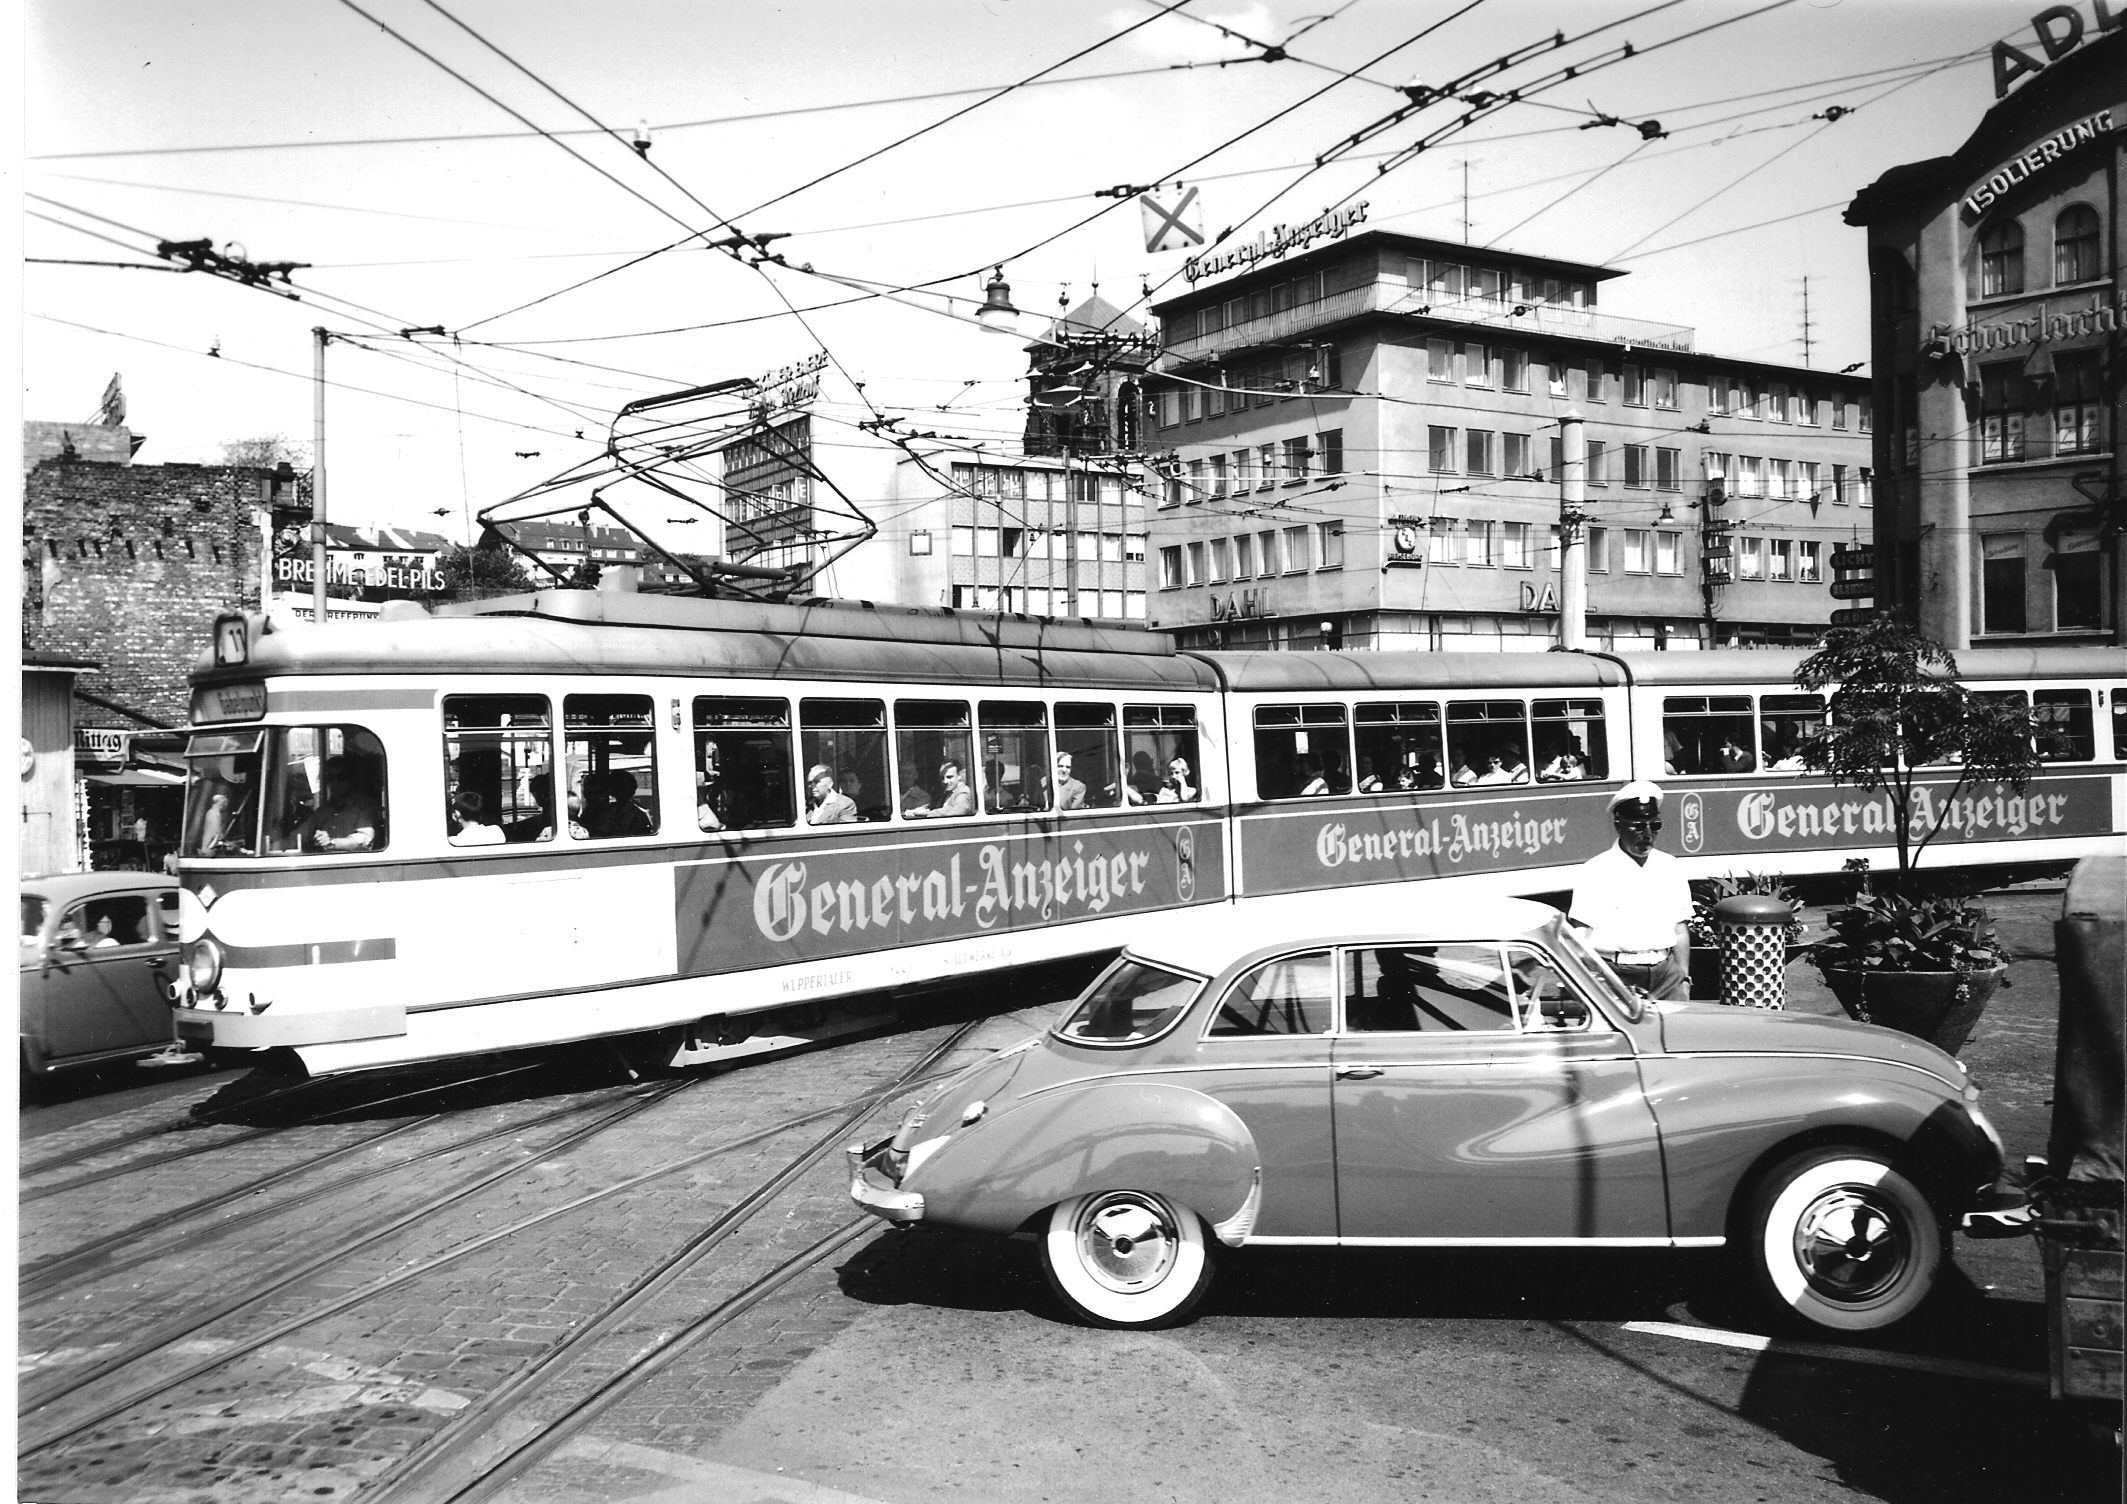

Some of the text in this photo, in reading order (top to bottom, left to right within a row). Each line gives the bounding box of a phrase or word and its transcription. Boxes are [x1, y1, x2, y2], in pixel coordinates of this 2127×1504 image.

[1965, 109, 2113, 214] ISOLIERUNG
[1182, 200, 1370, 283] General-Anzeiger
[365, 568, 446, 591] EDEL-PILS
[1834, 552, 1874, 567] LICHT
[1210, 587, 1279, 622] DAHL
[1519, 581, 1597, 612] DAL
[1317, 810, 1568, 867] General-Anzeiger
[1736, 786, 2068, 841] GeneralAnzeiger
[753, 839, 1150, 942] General-Anzeiger
